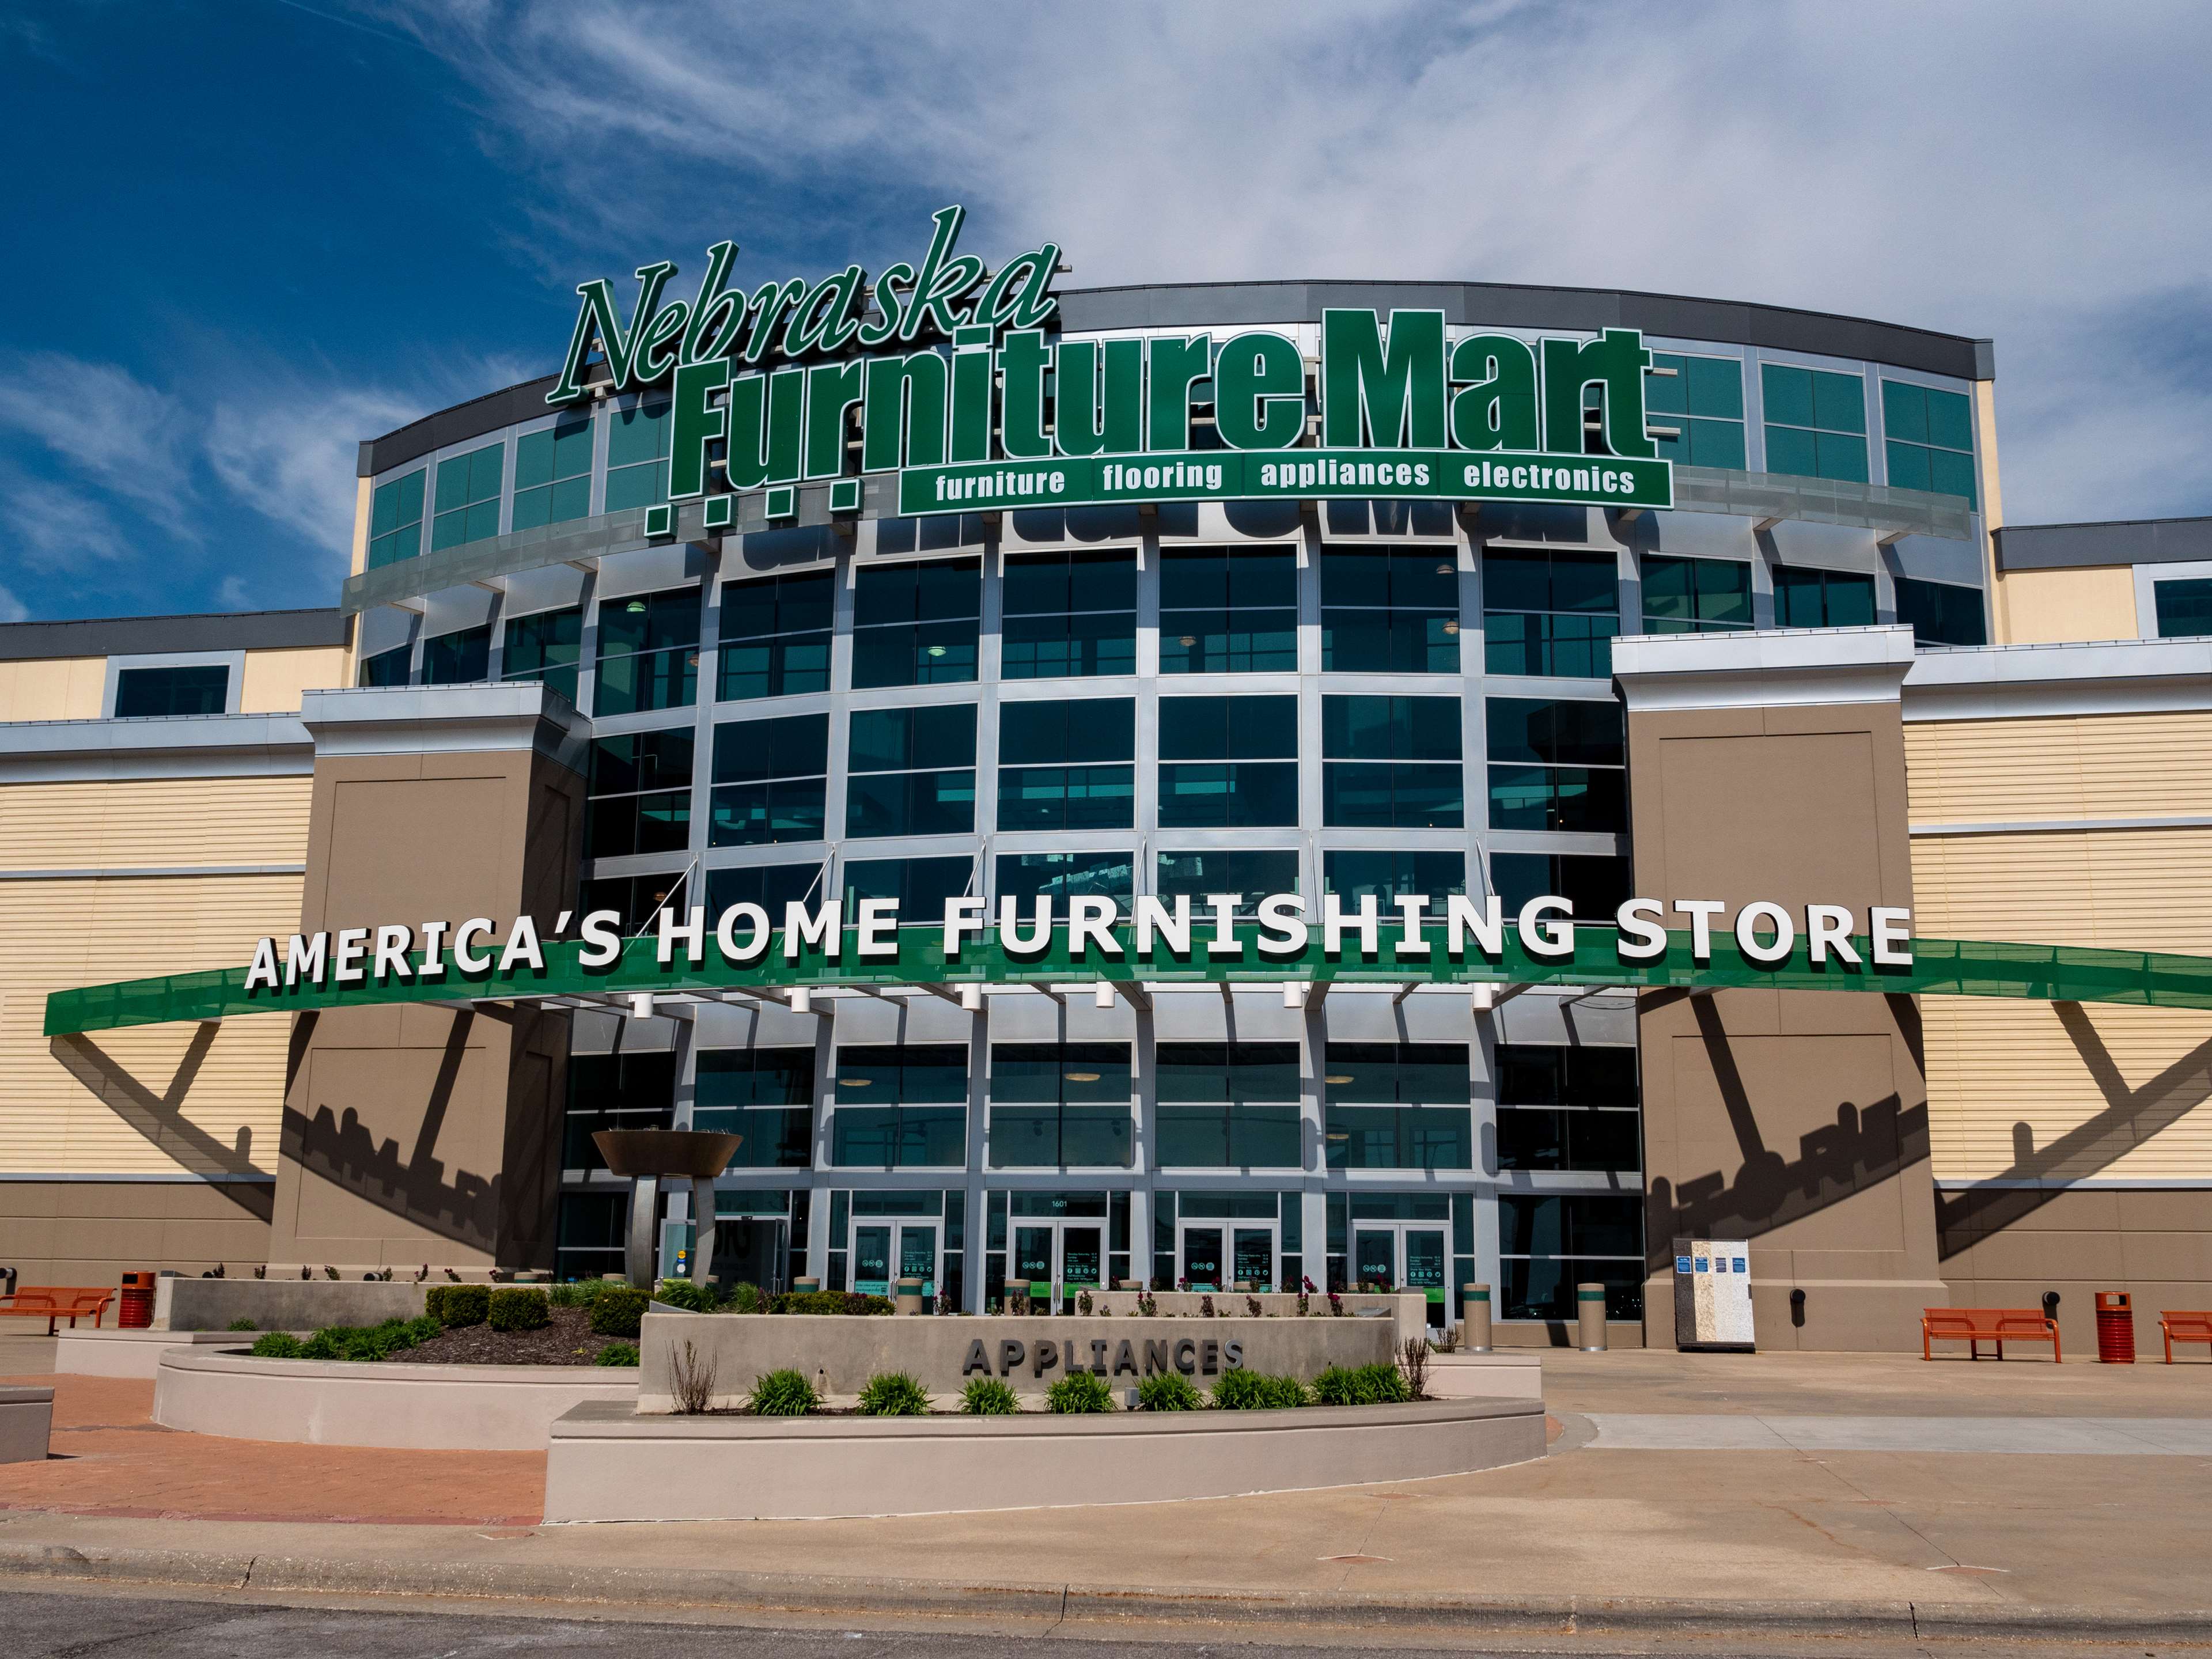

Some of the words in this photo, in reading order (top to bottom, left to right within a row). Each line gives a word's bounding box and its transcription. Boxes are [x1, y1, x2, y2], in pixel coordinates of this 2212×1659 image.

[546, 203, 1063, 407] Nebraska
[667, 323, 1308, 501] Furniture
[1319, 306, 1659, 459] Mart
[935, 471, 1066, 501] furniture
[1103, 461, 1222, 490] flooring
[1260, 459, 1430, 488] appliances
[1463, 461, 1635, 494] electronics
[244, 910, 622, 990] AMERICA'S
[657, 897, 900, 963] HOME
[943, 893, 1575, 957] FURNISHING
[1616, 897, 1913, 966] STORE
[963, 1338, 1244, 1376] APPLIANCES
